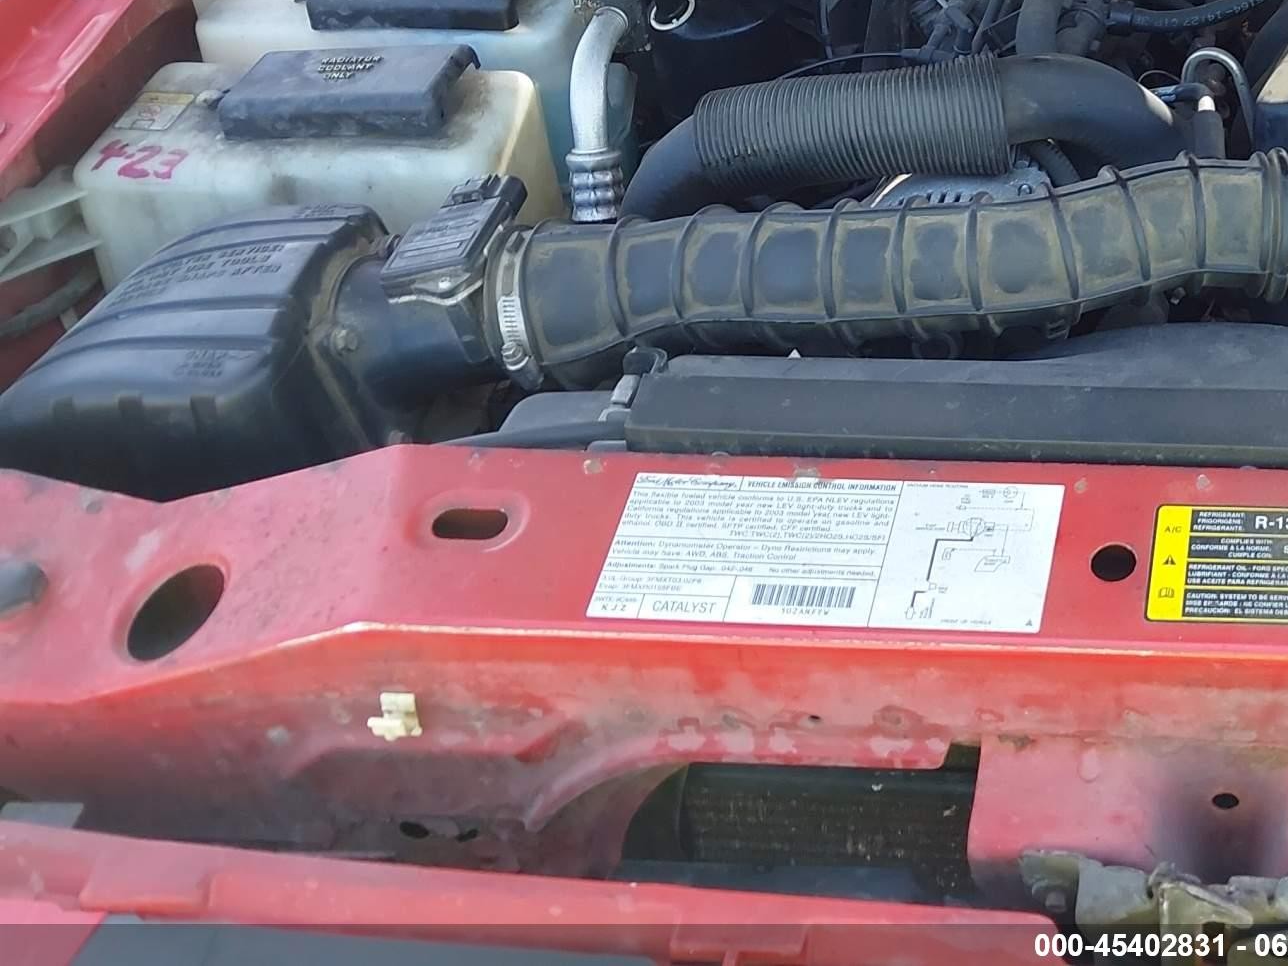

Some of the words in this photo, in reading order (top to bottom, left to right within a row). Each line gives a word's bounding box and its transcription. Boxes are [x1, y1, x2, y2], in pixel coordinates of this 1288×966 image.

[321, 55, 383, 65] RADIATOR
[317, 63, 374, 73] COOLANT
[322, 71, 355, 81] ONLY
[747, 480, 775, 488] VEHICLE
[776, 481, 811, 489] EMISSION
[812, 482, 846, 490] CONTROL
[847, 483, 897, 491] INFORMATION
[1164, 526, 1182, 534] A/C
[1190, 543, 1228, 551] CONFORME
[650, 599, 716, 613] CATALYST
